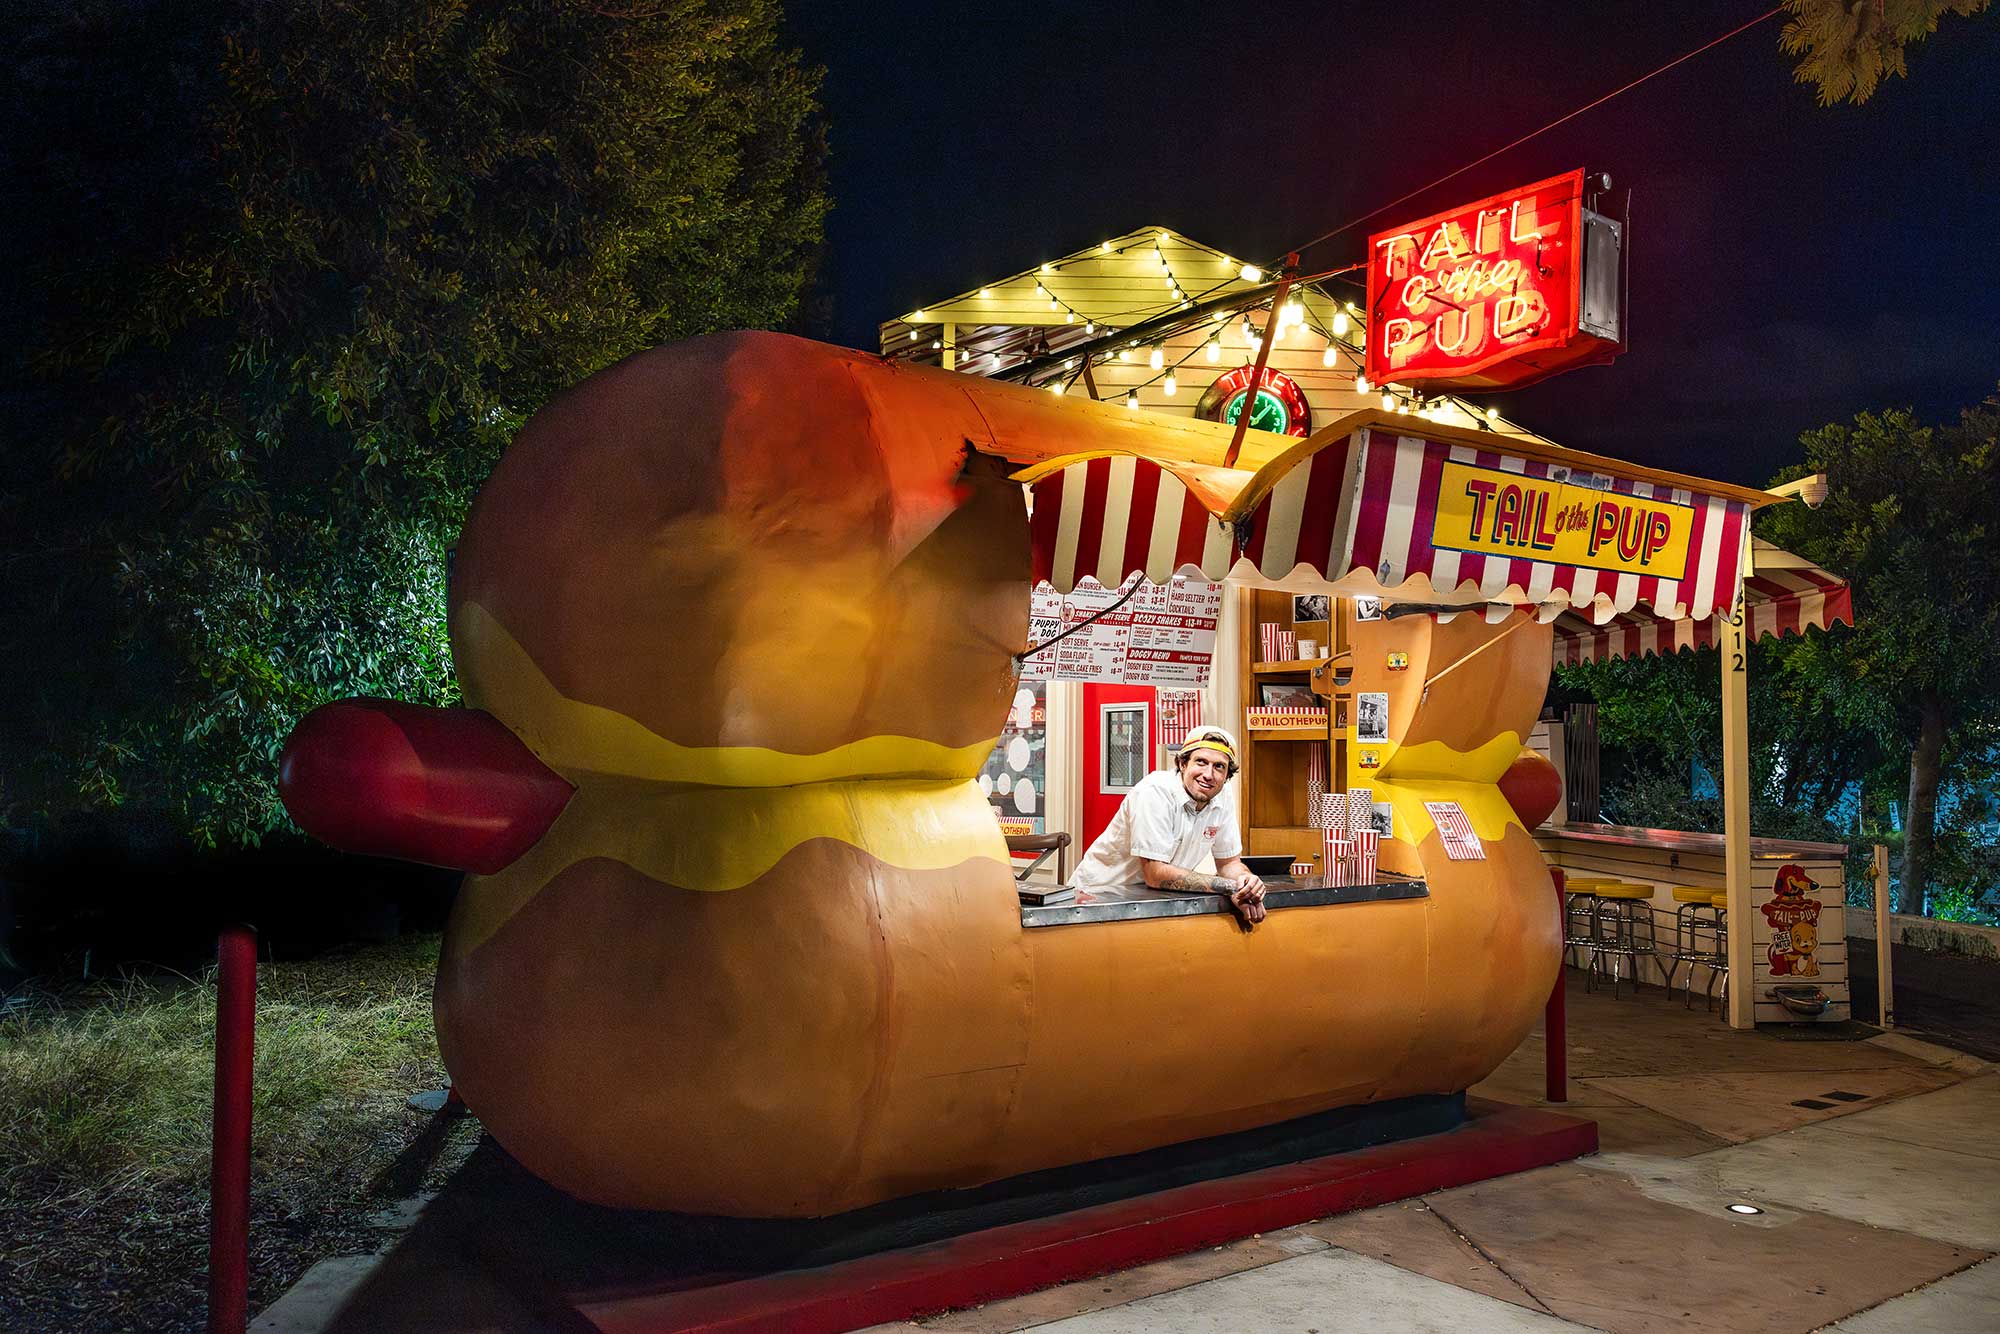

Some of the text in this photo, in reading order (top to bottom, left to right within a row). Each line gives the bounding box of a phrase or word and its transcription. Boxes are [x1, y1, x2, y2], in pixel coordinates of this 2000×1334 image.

[1376, 195, 1561, 282] TAIL
[1385, 289, 1551, 370] PUP
[1467, 479, 1672, 567] TAIL o'the PUP
[1171, 592, 1185, 602] HARD
[1185, 593, 1205, 603] SELTZER
[1169, 603, 1195, 615] COCKTAILS
[1114, 614, 1131, 622] SERVE
[1133, 613, 1155, 624] BOOZY
[1156, 615, 1182, 626] SHAKES
[1034, 618, 1060, 629] PUPPY
[1040, 628, 1057, 638] DOG
[1074, 638, 1090, 648] SERVE
[1060, 651, 1073, 660] SODA
[1073, 651, 1088, 661] FLOAT
[1129, 649, 1152, 659] DOGGY
[1151, 651, 1171, 660] MENU
[1057, 663, 1075, 673] FUNNEL
[1075, 664, 1090, 674] CAKE
[1090, 665, 1103, 675] FRIES
[1127, 662, 1141, 671] DOGGY
[1141, 663, 1153, 672] BEER
[1125, 672, 1140, 681] DOGGY
[1140, 673, 1150, 681] DOG
[1183, 691, 1197, 699] PUP
[1250, 716, 1328, 726] @TAILOTHEPUP
[1774, 910, 1793, 924] TAIL
[1799, 909, 1817, 921] PUP
[1774, 932, 1790, 942] FREE
[1774, 940, 1791, 950] WATER
